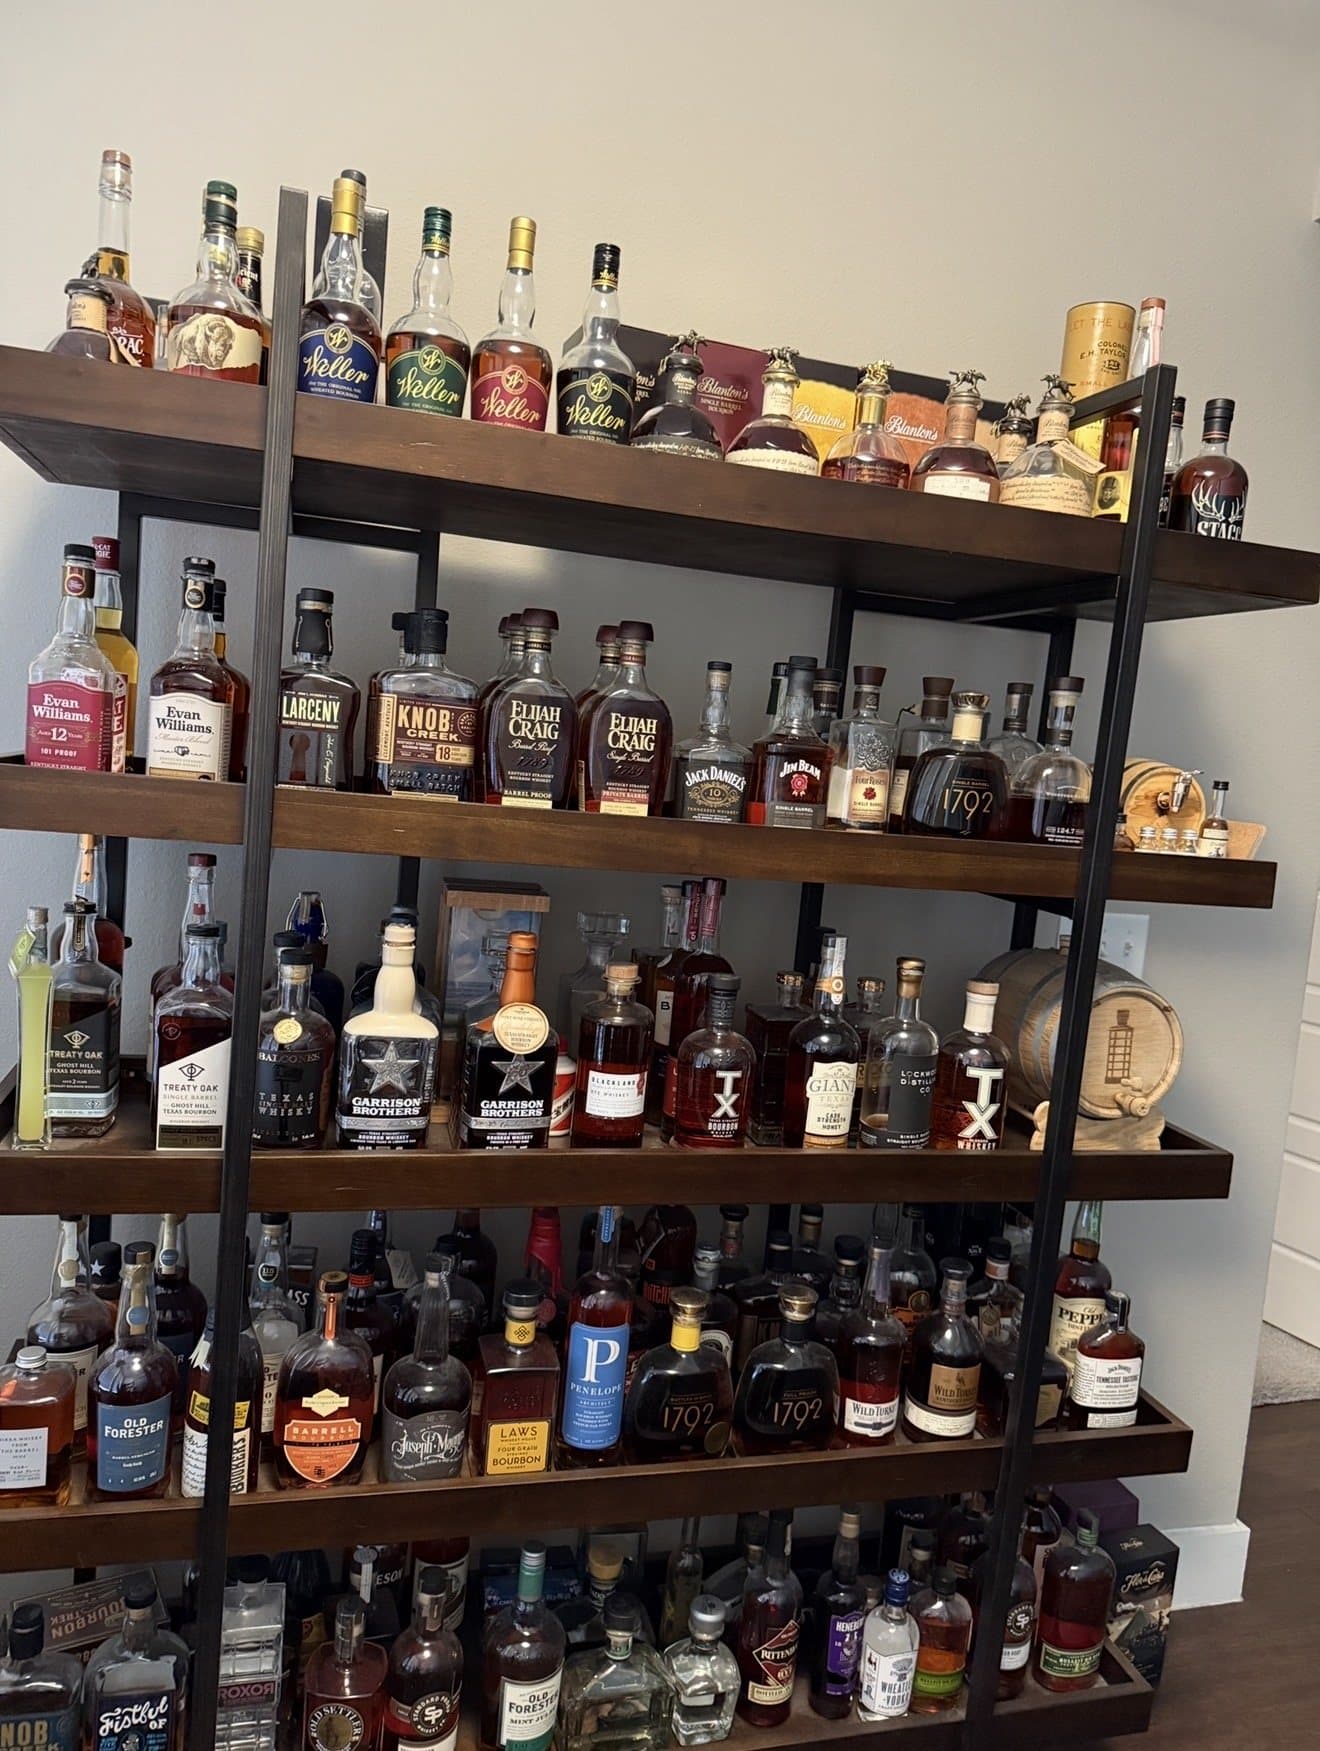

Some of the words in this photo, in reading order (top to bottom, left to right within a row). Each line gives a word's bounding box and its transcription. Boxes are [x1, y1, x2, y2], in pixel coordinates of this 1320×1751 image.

[303, 345, 369, 383] Weller
[397, 367, 461, 405] Weller
[697, 377, 749, 400] Blanton's
[481, 387, 541, 423] Weller
[566, 394, 627, 430] Weller
[792, 405, 847, 430] Blanton's
[884, 415, 938, 441] Blanton's
[43, 694, 80, 709] Evan
[167, 706, 201, 720] Evan
[282, 696, 340, 722] LARCENY
[511, 700, 561, 721] ELIJAH
[398, 704, 450, 731] KNOB
[609, 713, 658, 734] ELIJAH
[51, 727, 68, 742] 12
[508, 719, 559, 740] CRAIG
[607, 731, 655, 751] CRAIG
[55, 749, 77, 757] PROOF
[439, 746, 451, 760] 18
[780, 760, 799, 778] JIM
[799, 759, 821, 780] BEAM
[685, 768, 709, 787] JACK
[710, 766, 747, 791] DANIEL'S
[504, 789, 529, 797] BARREL
[709, 788, 720, 797] 10
[943, 789, 993, 820] 1792
[49, 1050, 83, 1058] TREATY
[84, 1051, 103, 1059] OAK
[258, 1052, 320, 1063] BALCONES
[200, 1084, 219, 1092] OAK
[259, 1092, 314, 1102] TEXAS
[351, 1097, 421, 1107] GARRISON
[258, 1107, 313, 1116] WHISKY
[352, 1106, 421, 1116] BROTHERS
[480, 1100, 544, 1110] GARRISON
[480, 1108, 544, 1117] BROTHERS
[708, 1122, 738, 1130] BOURBON
[581, 1337, 620, 1383] P
[570, 1382, 622, 1395] PENELOPE
[773, 1398, 822, 1431] 1792
[853, 1403, 875, 1416] WILD
[124, 1418, 147, 1428] OLD
[664, 1403, 714, 1436] 1792
[105, 1420, 163, 1439] FORESTER
[292, 1426, 354, 1435] BARRELL
[501, 1426, 537, 1438] LAWS
[392, 1429, 434, 1463] Joseph
[492, 1456, 541, 1466] BOURBON
[528, 1692, 548, 1705] OLD
[509, 1717, 532, 1725] MINT
